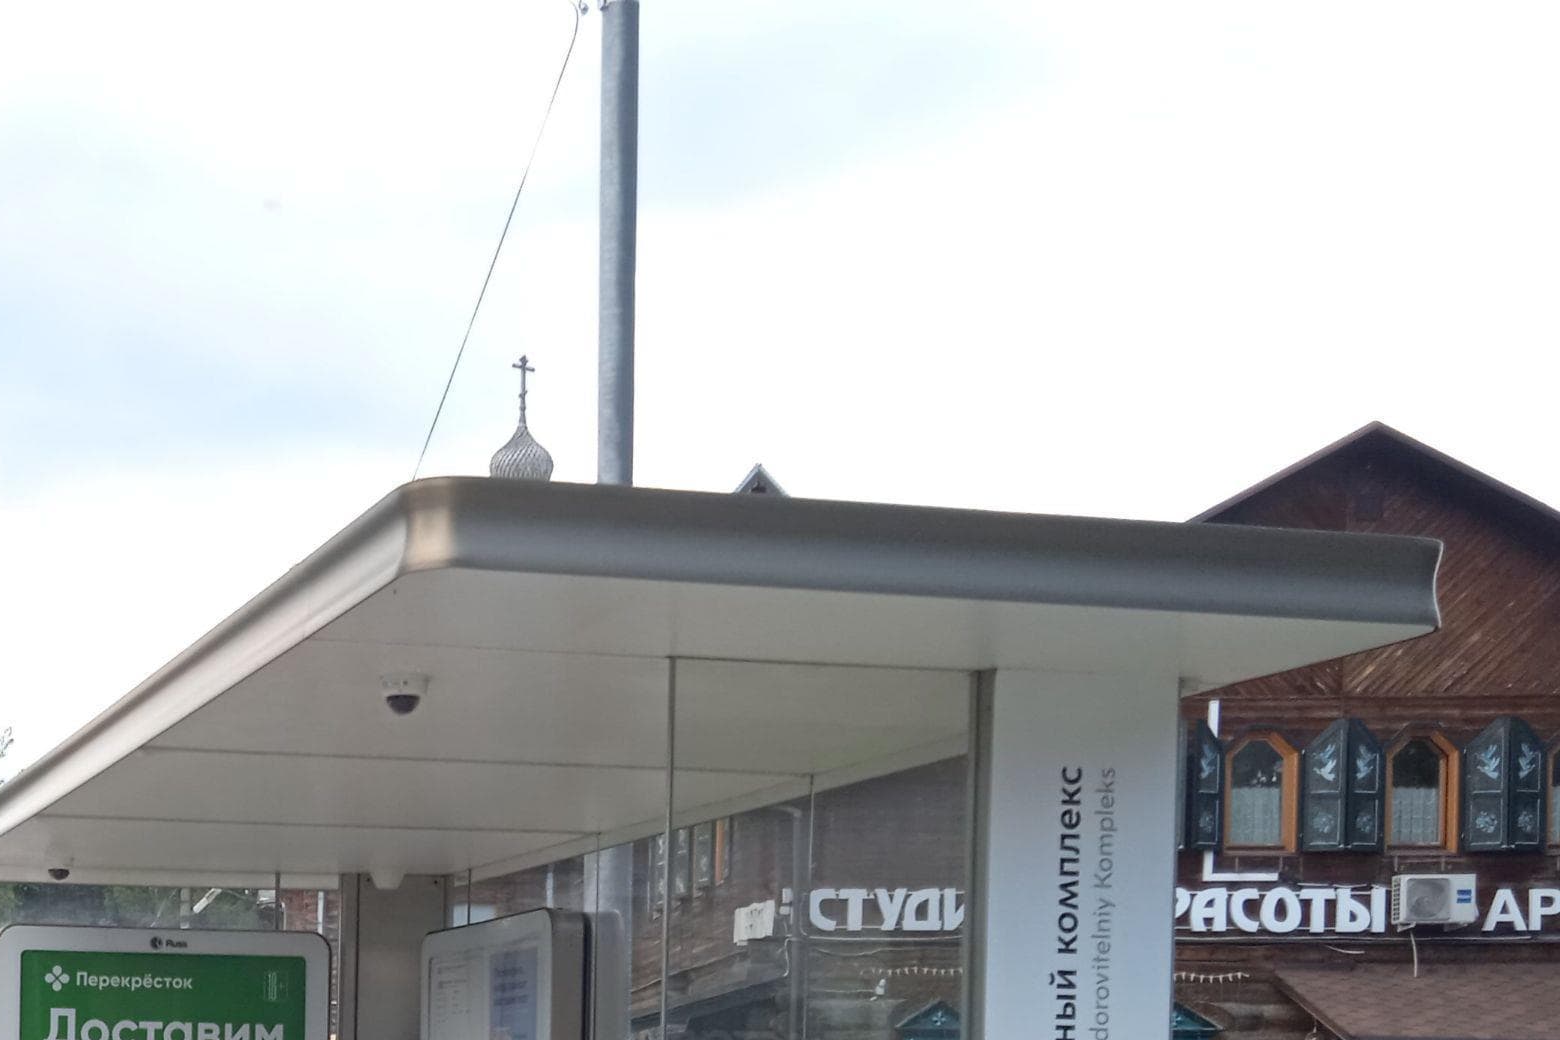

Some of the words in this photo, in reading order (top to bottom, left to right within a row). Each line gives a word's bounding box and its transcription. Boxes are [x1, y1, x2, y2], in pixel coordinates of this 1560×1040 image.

[1056, 765, 1084, 954] комплекс
[1093, 766, 1118, 890] Kompleks
[75, 971, 194, 991] Перекрёсток
